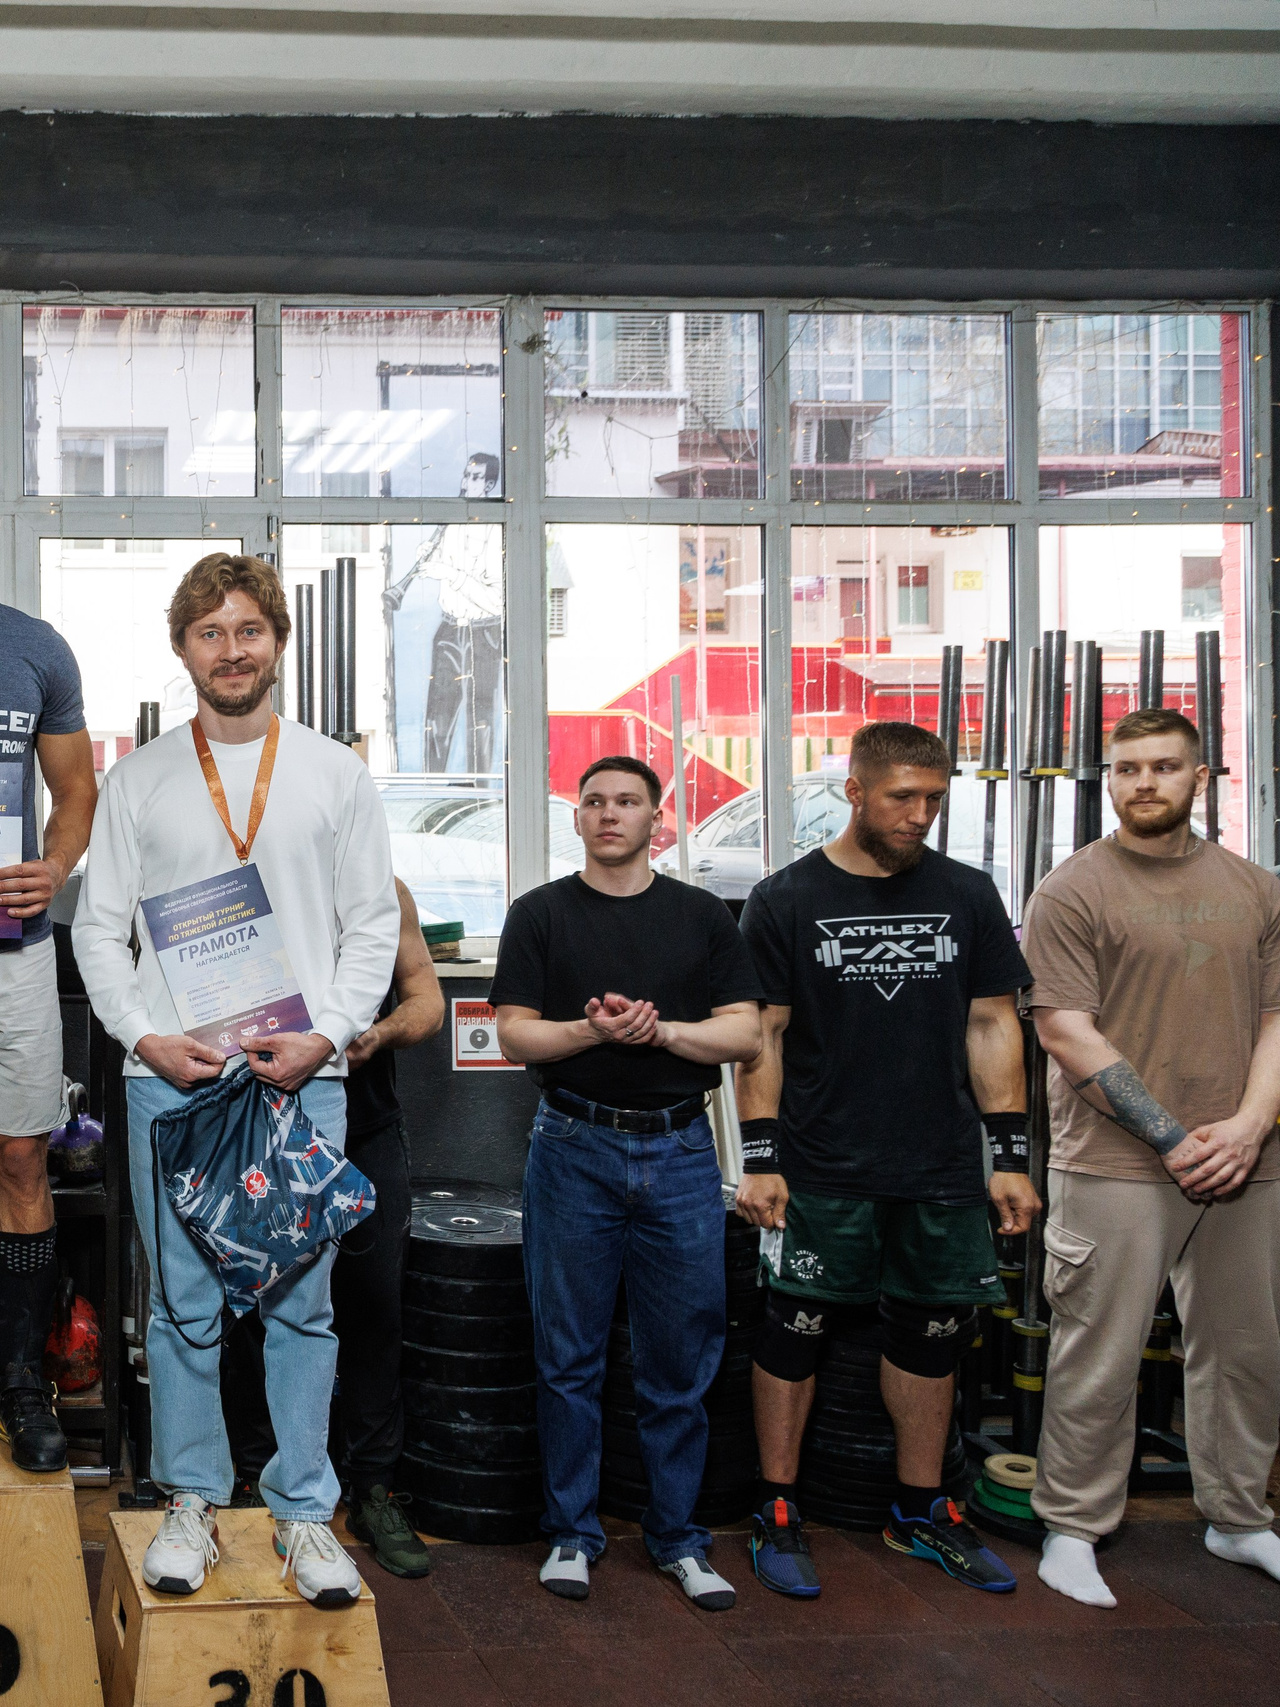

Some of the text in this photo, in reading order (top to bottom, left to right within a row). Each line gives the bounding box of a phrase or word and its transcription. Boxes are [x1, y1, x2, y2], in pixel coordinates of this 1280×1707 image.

[159, 883, 248, 917] МНОГОБОРЬЯ СВЕРДЛОВСКОЙ ОБЛАСТИ
[164, 879, 239, 909] ФЕДЕРАЦИЯ ФУНКЦИОНАЛЬНОГО
[168, 907, 256, 943] ПО ТЯЖЕЛОЙ АТЛЕТИКЕ
[172, 901, 246, 932] ОТКРЫТЫЙ ТУРНИР
[178, 924, 259, 963] ГРАМОТА
[838, 923, 935, 938] ATHLEX
[196, 945, 250, 968] НАГРАЖДАЕТСЯ
[842, 962, 938, 974] ATHLETE
[223, 1013, 255, 1028] ЕКАТЕРИНБУРГ
[458, 1006, 490, 1016] СОБИРАЙ
